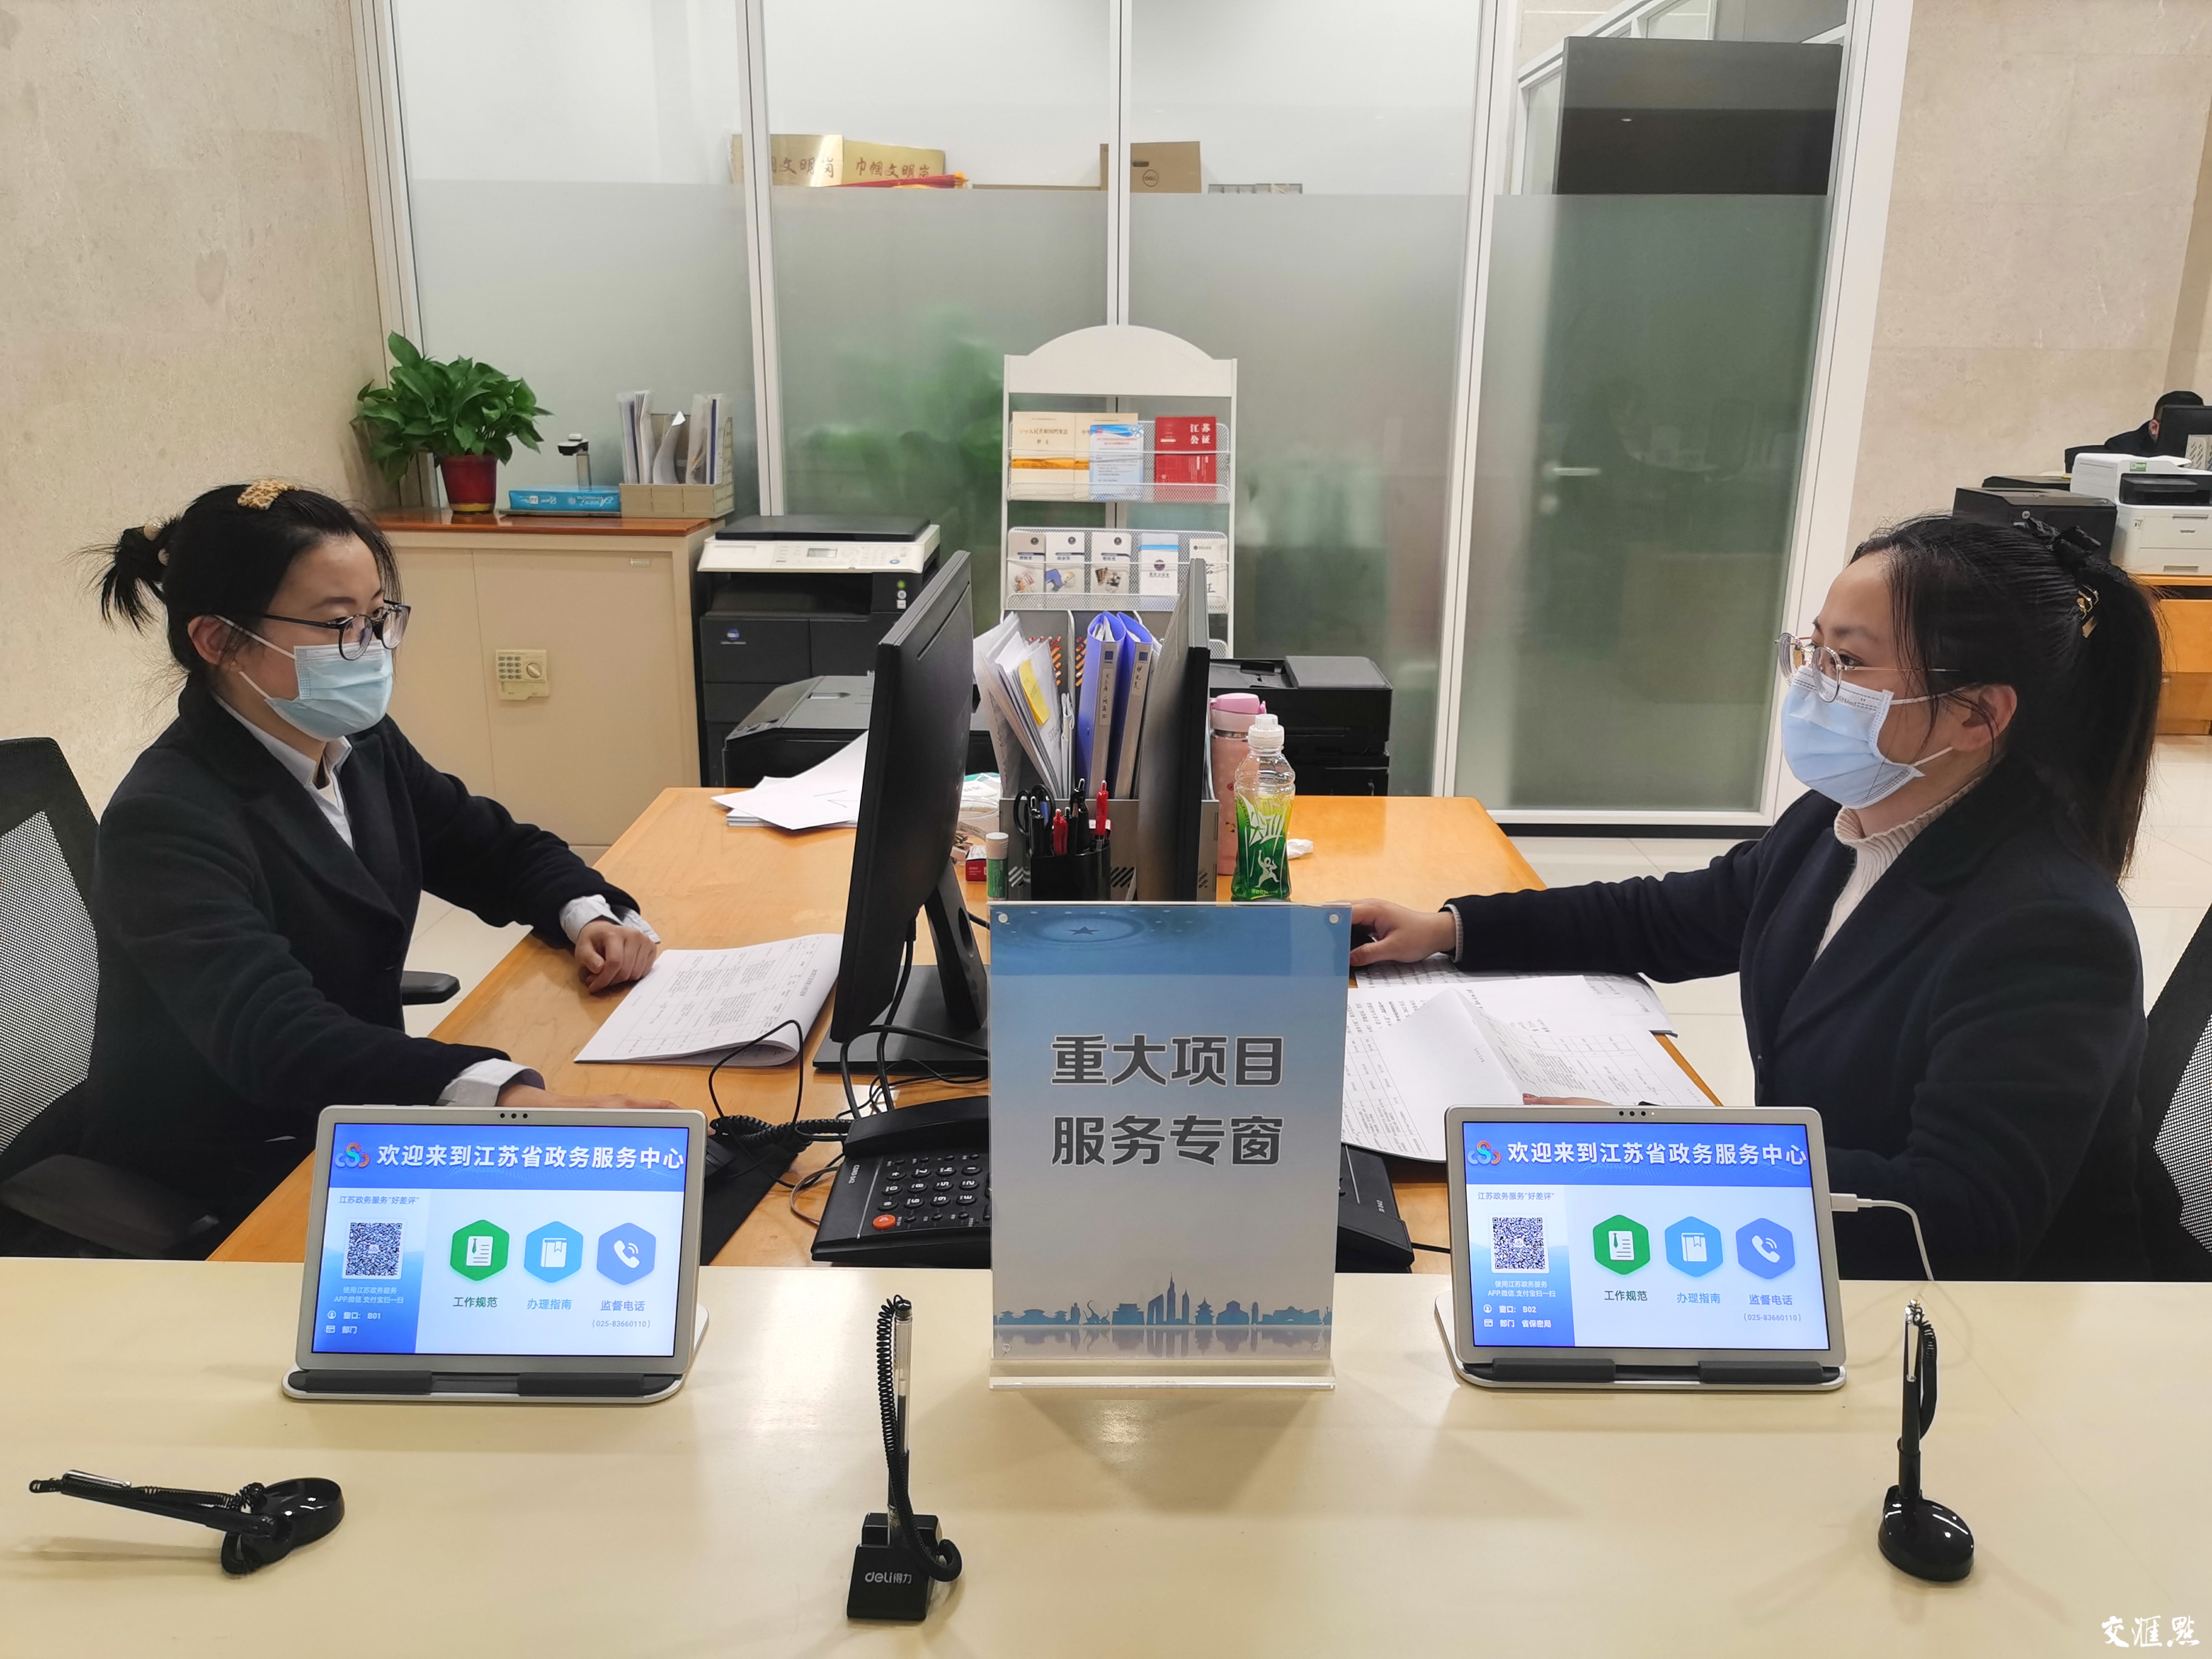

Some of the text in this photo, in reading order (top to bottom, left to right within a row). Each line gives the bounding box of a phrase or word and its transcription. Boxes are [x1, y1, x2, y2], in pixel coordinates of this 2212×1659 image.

[1190, 423, 1211, 433] 江苏
[1190, 435, 1211, 444] 公证
[1050, 1033, 1284, 1087] 重大项目
[1050, 1114, 1284, 1167] 服务专窗
[377, 1144, 685, 1170] 欢迎来到江苏省政务服务中心
[1507, 1141, 1808, 1167] 欢迎来到江苏省政务服务中心
[1495, 1280, 1548, 1289] 使用江苏政务服务
[1604, 1290, 1648, 1302] 工作规范
[1677, 1292, 1721, 1304] 办理指南
[1749, 1294, 1793, 1305] 监督电话
[452, 1296, 498, 1308] 工作规范
[527, 1299, 572, 1310] 办理指南
[600, 1300, 646, 1312] 监督电话
[1743, 1313, 1801, 1322] (025-83660110)
[592, 1319, 651, 1329] (025-83660110)
[1500, 1319, 1552, 1328] 部门 省保密局
[341, 1326, 358, 1334] 部门
